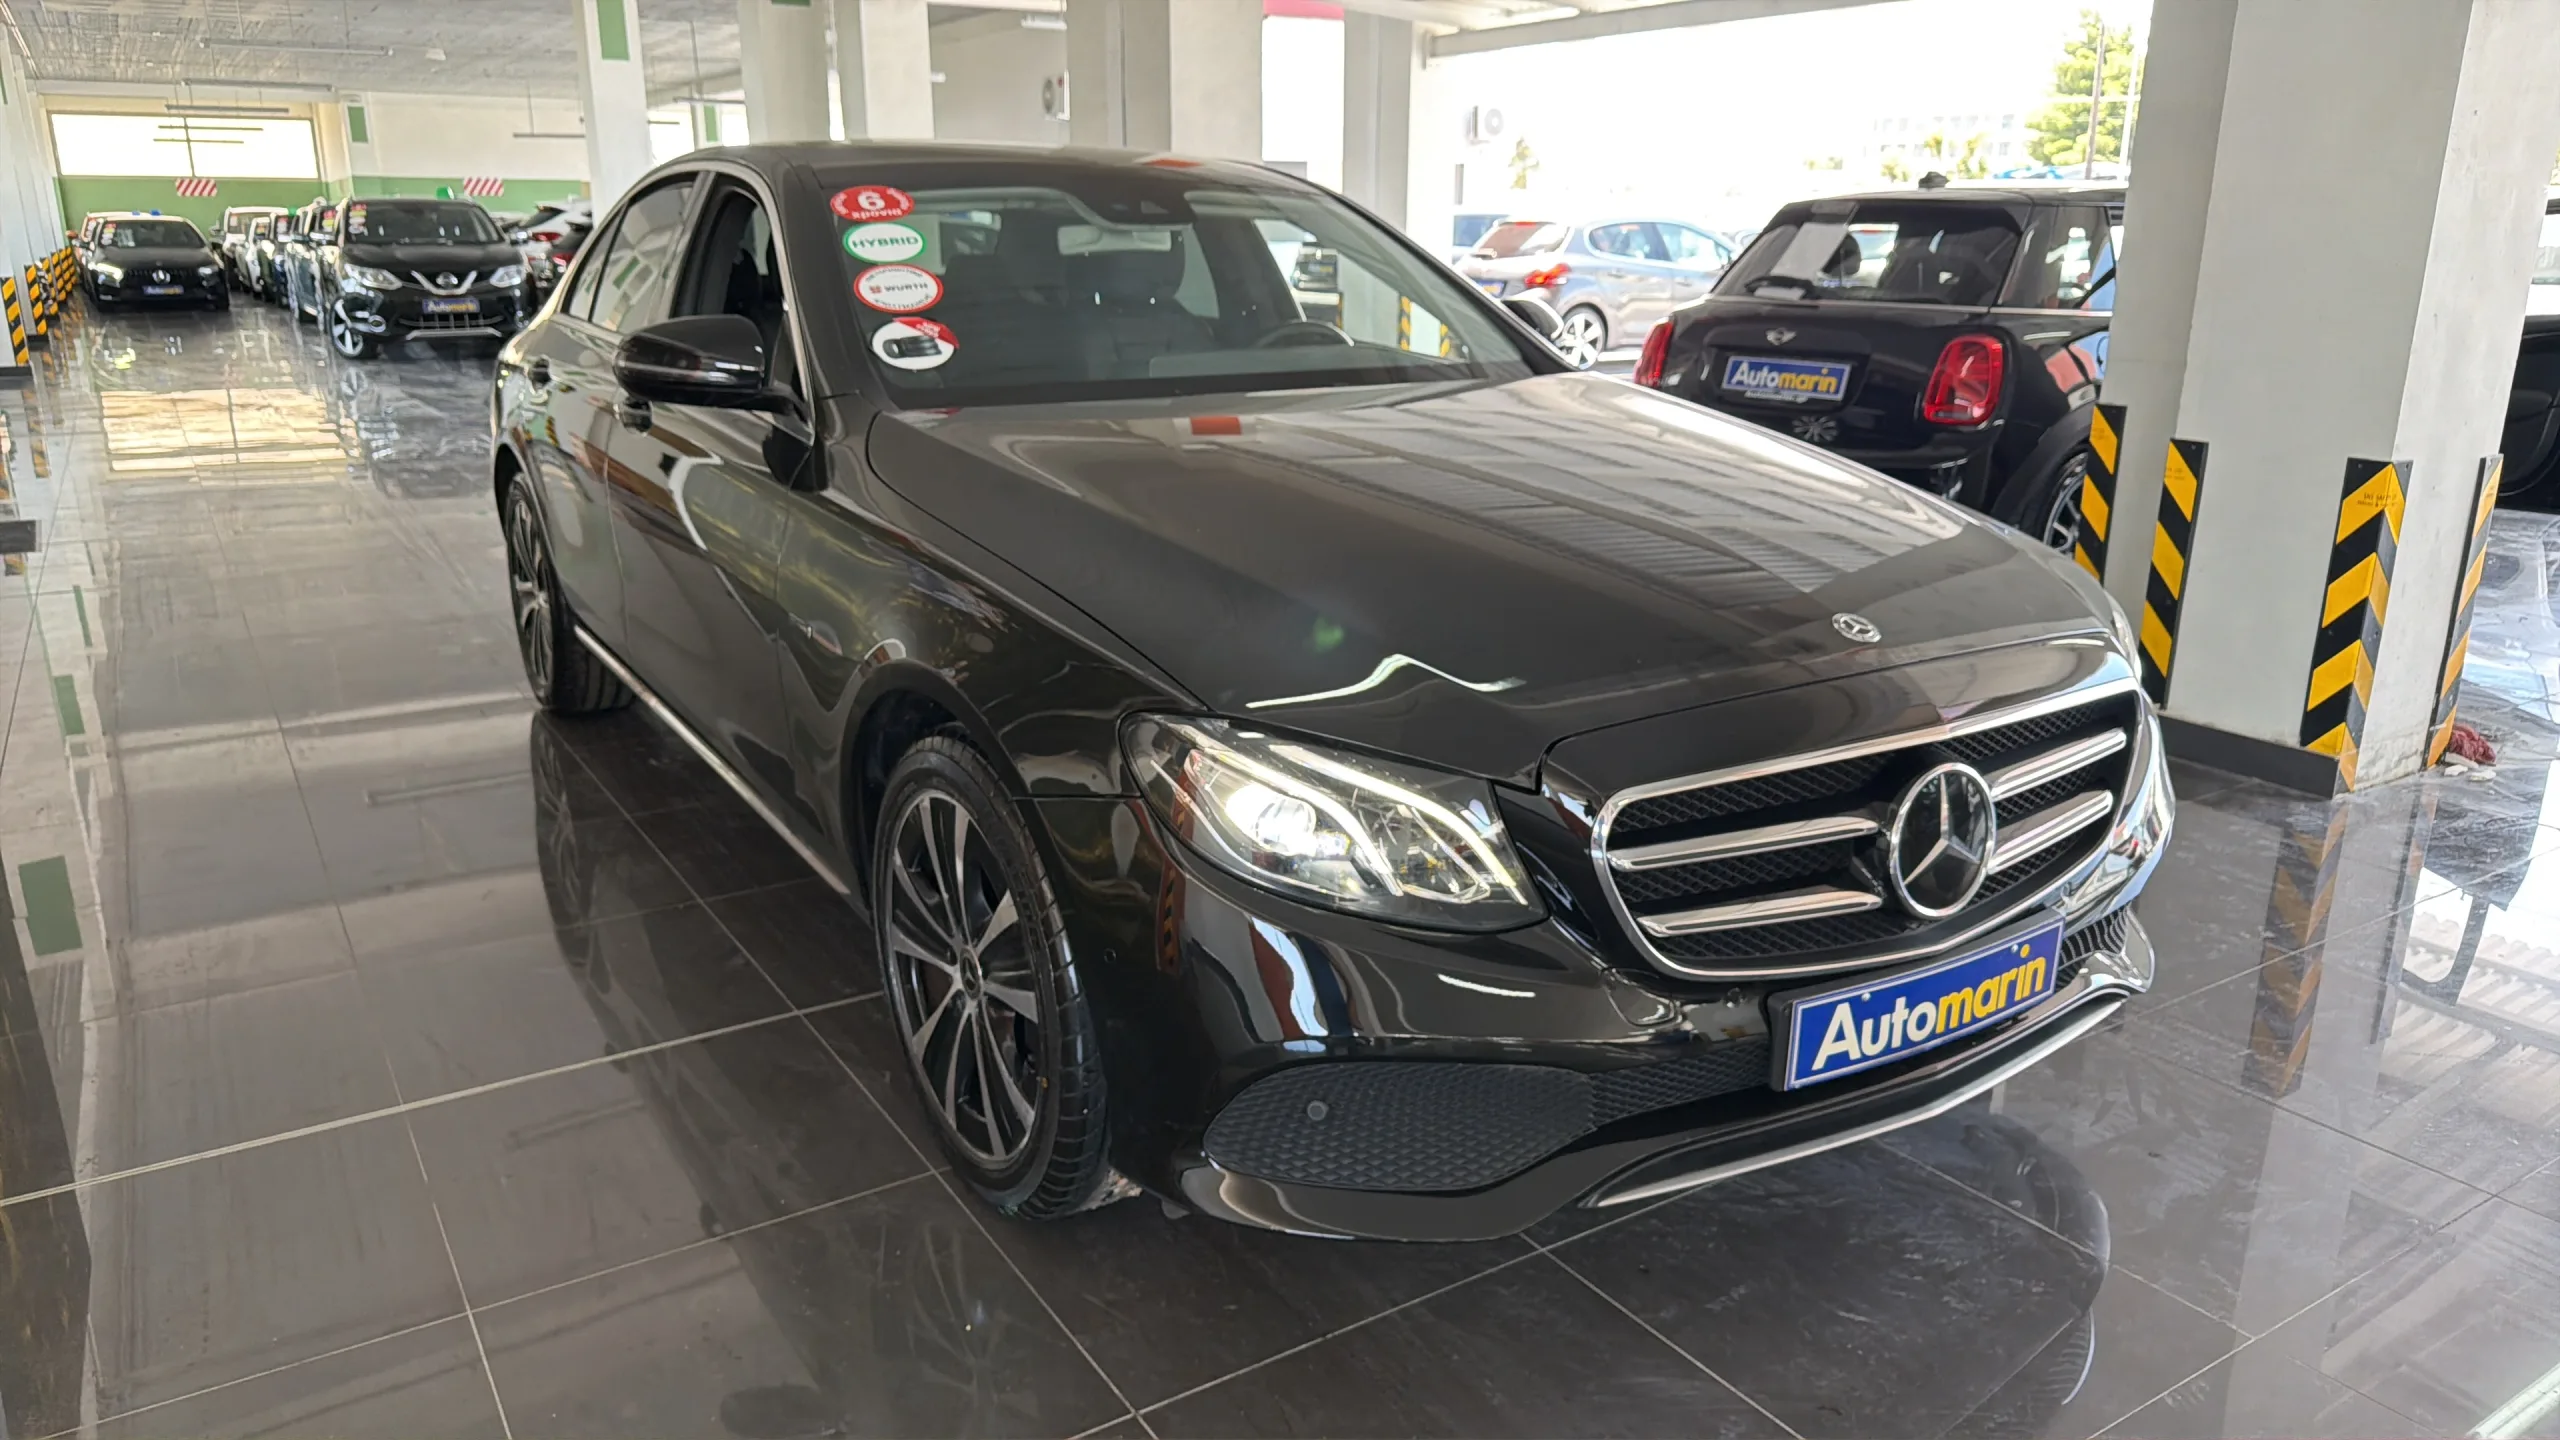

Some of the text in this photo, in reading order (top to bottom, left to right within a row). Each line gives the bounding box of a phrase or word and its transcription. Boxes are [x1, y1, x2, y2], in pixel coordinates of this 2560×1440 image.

[858, 191, 885, 211] 6
[852, 236, 919, 248] HYBRID
[1731, 360, 1839, 394] Automarin
[1811, 943, 2047, 1071] Automarin
